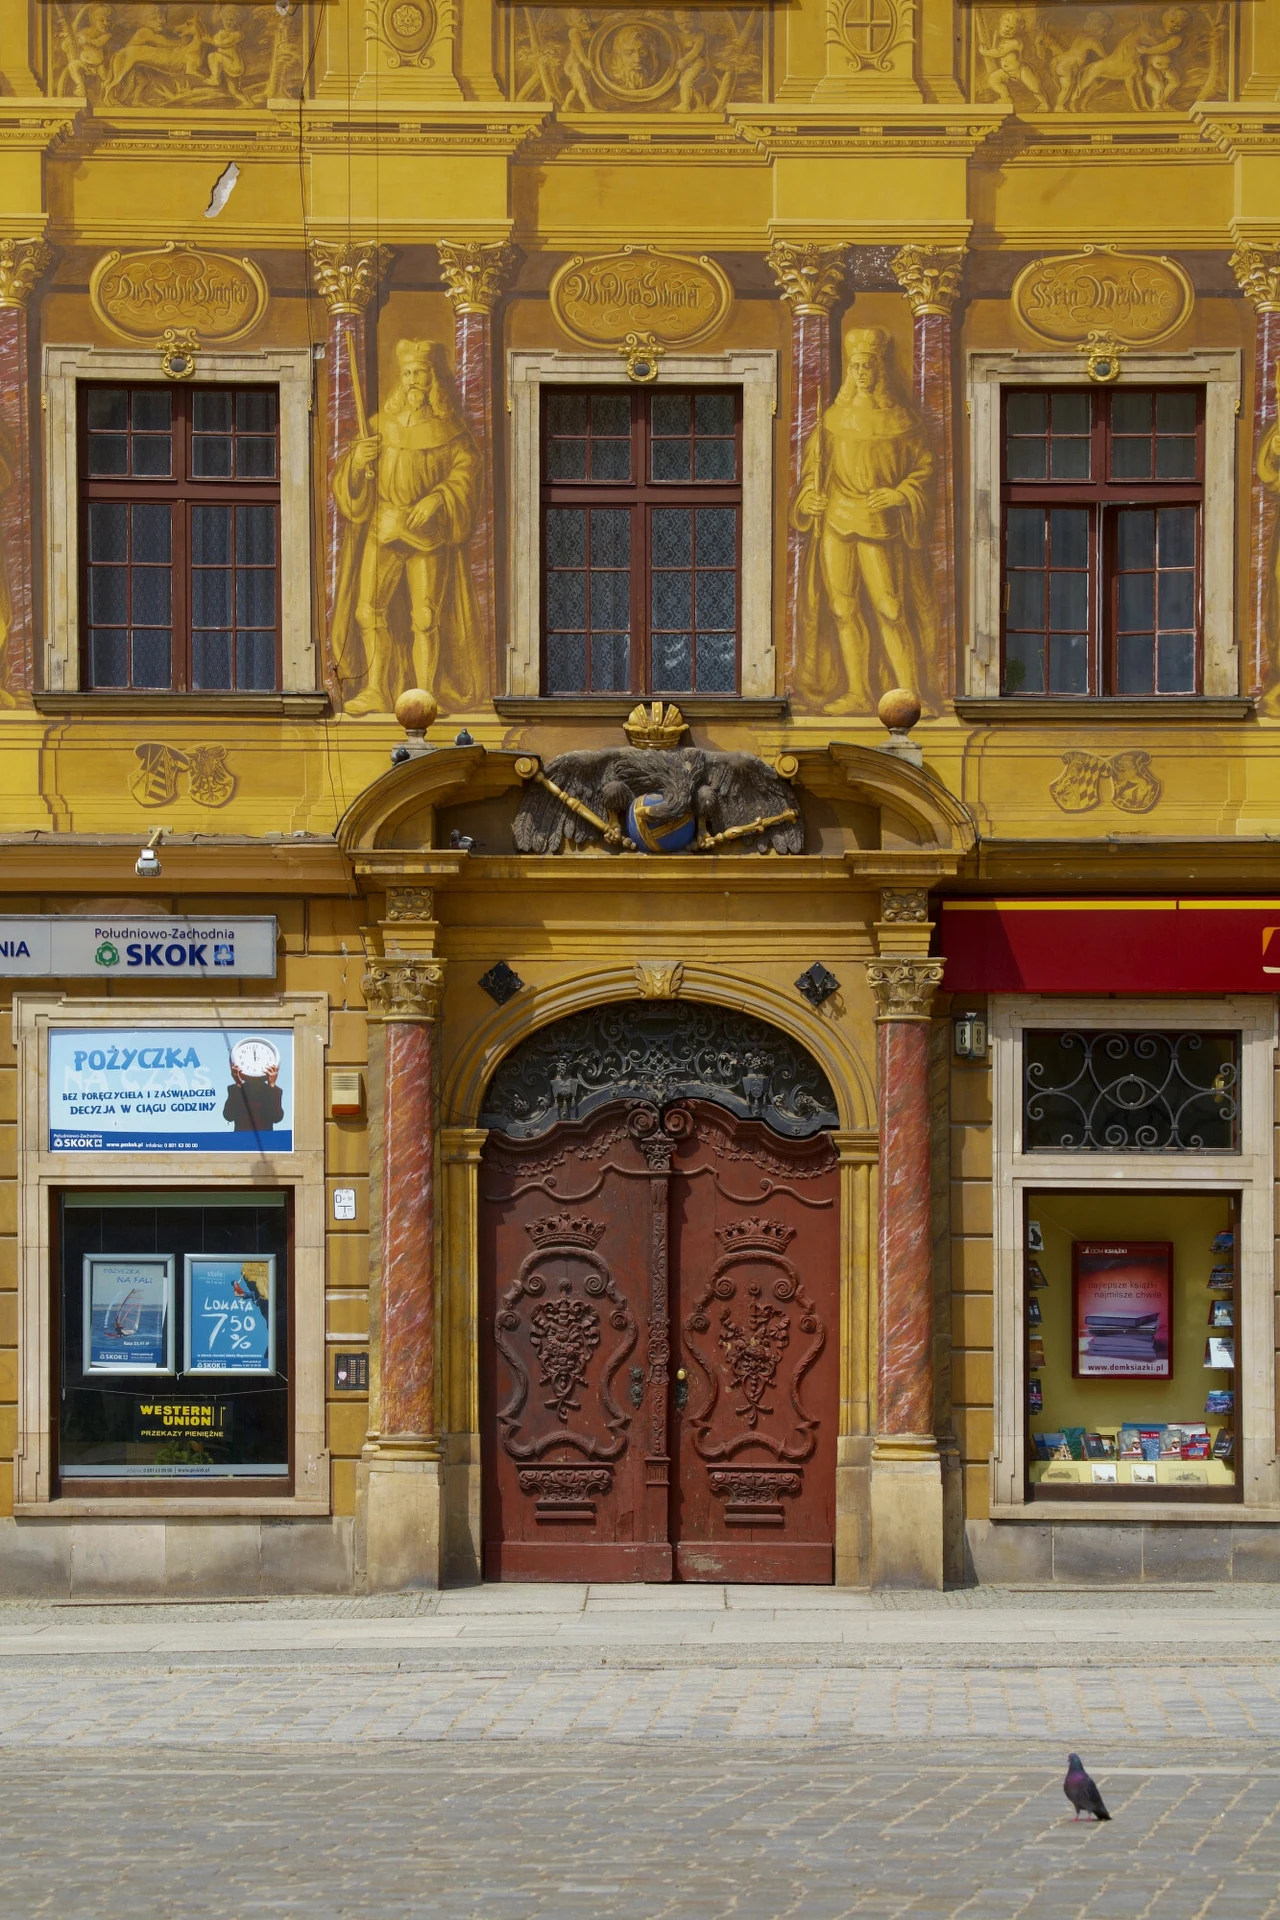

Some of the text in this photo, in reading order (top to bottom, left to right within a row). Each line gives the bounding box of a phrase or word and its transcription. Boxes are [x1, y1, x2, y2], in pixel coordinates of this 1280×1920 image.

[95, 928, 235, 941] Południowo-Zachodnia
[127, 944, 208, 967] SKOK
[73, 1045, 201, 1071] POŻYCZKA
[64, 1065, 213, 1095] NA CZAS
[62, 1092, 78, 1101] BEZ
[82, 1091, 143, 1102] PORĘCZYCIELA
[70, 1101, 217, 1115] DECYZJA W CIĄGU GODZINY
[64, 1138, 94, 1148] SKOK
[1094, 1290, 1162, 1300] najmilsze chwile
[204, 1296, 254, 1312] LOKATA
[1088, 1363, 1164, 1373] www.domksiazki.pl
[140, 1405, 212, 1416] WESTERN
[163, 1415, 212, 1426] UNION
[185, 1430, 224, 1439] PIENIĘŻNE
